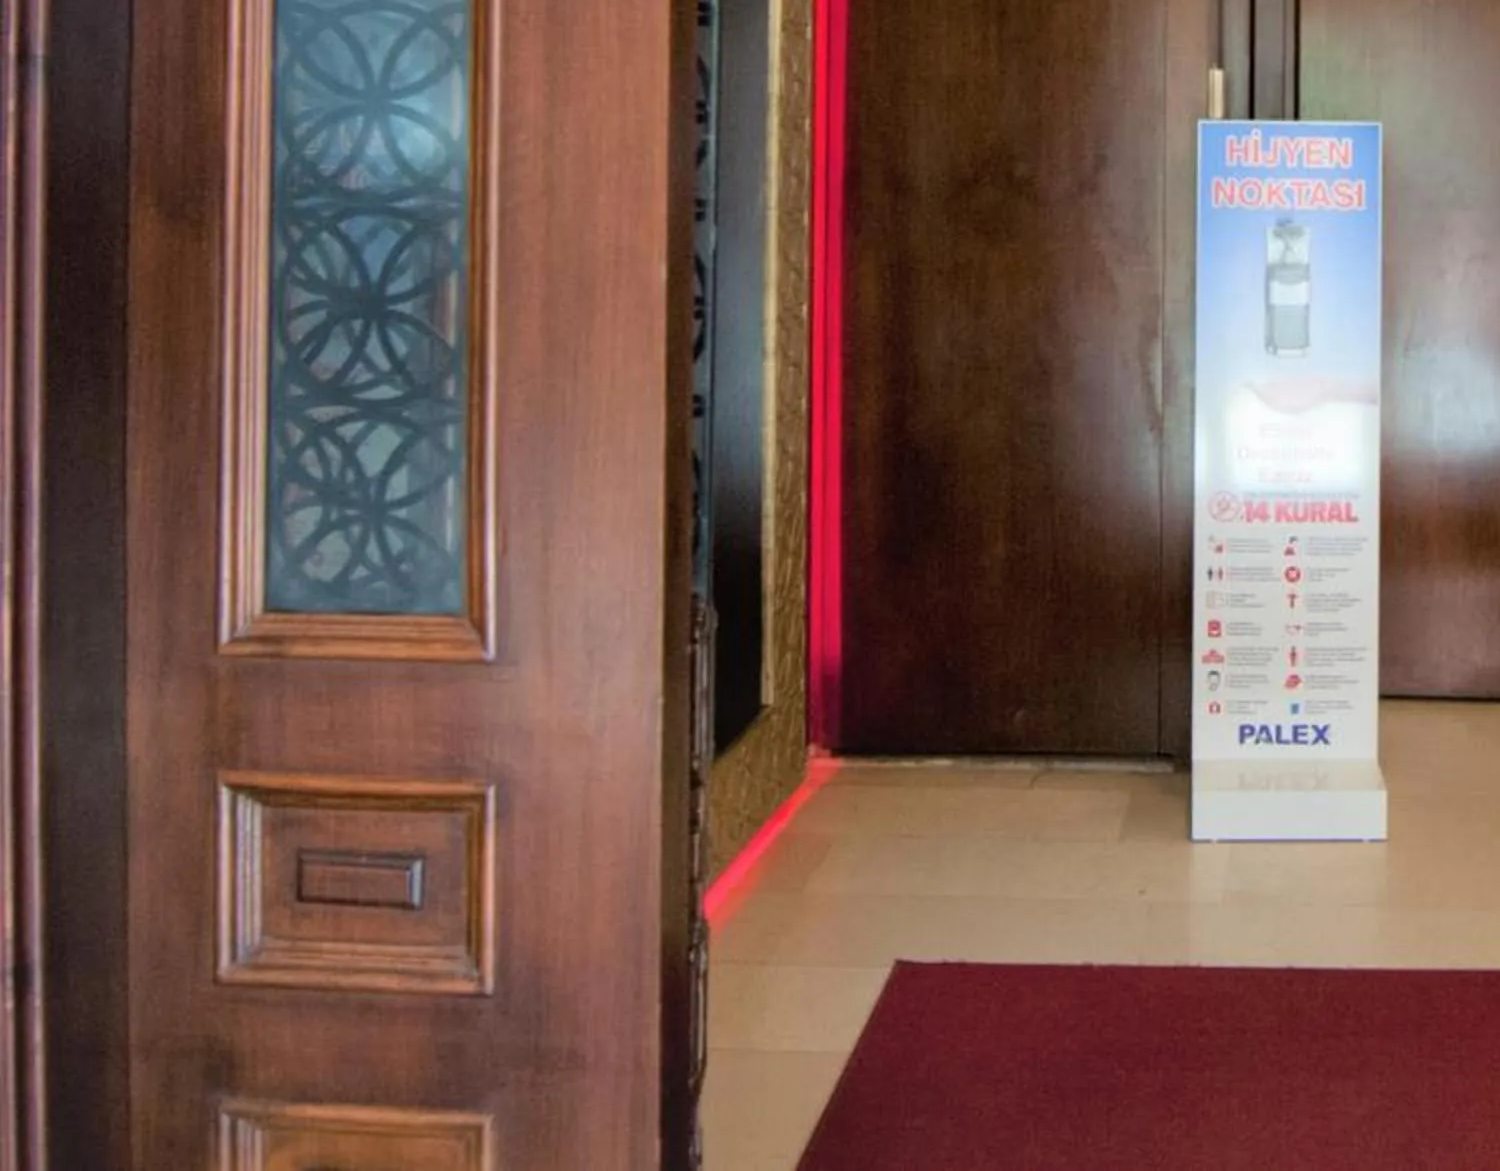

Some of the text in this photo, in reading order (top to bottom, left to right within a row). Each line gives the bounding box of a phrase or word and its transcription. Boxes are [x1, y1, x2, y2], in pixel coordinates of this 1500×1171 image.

[1226, 129, 1353, 168] HİJYEN
[1212, 177, 1367, 210] NOKTASI
[1243, 500, 1359, 523] 14 KURAL
[1239, 724, 1331, 746] PALEX
